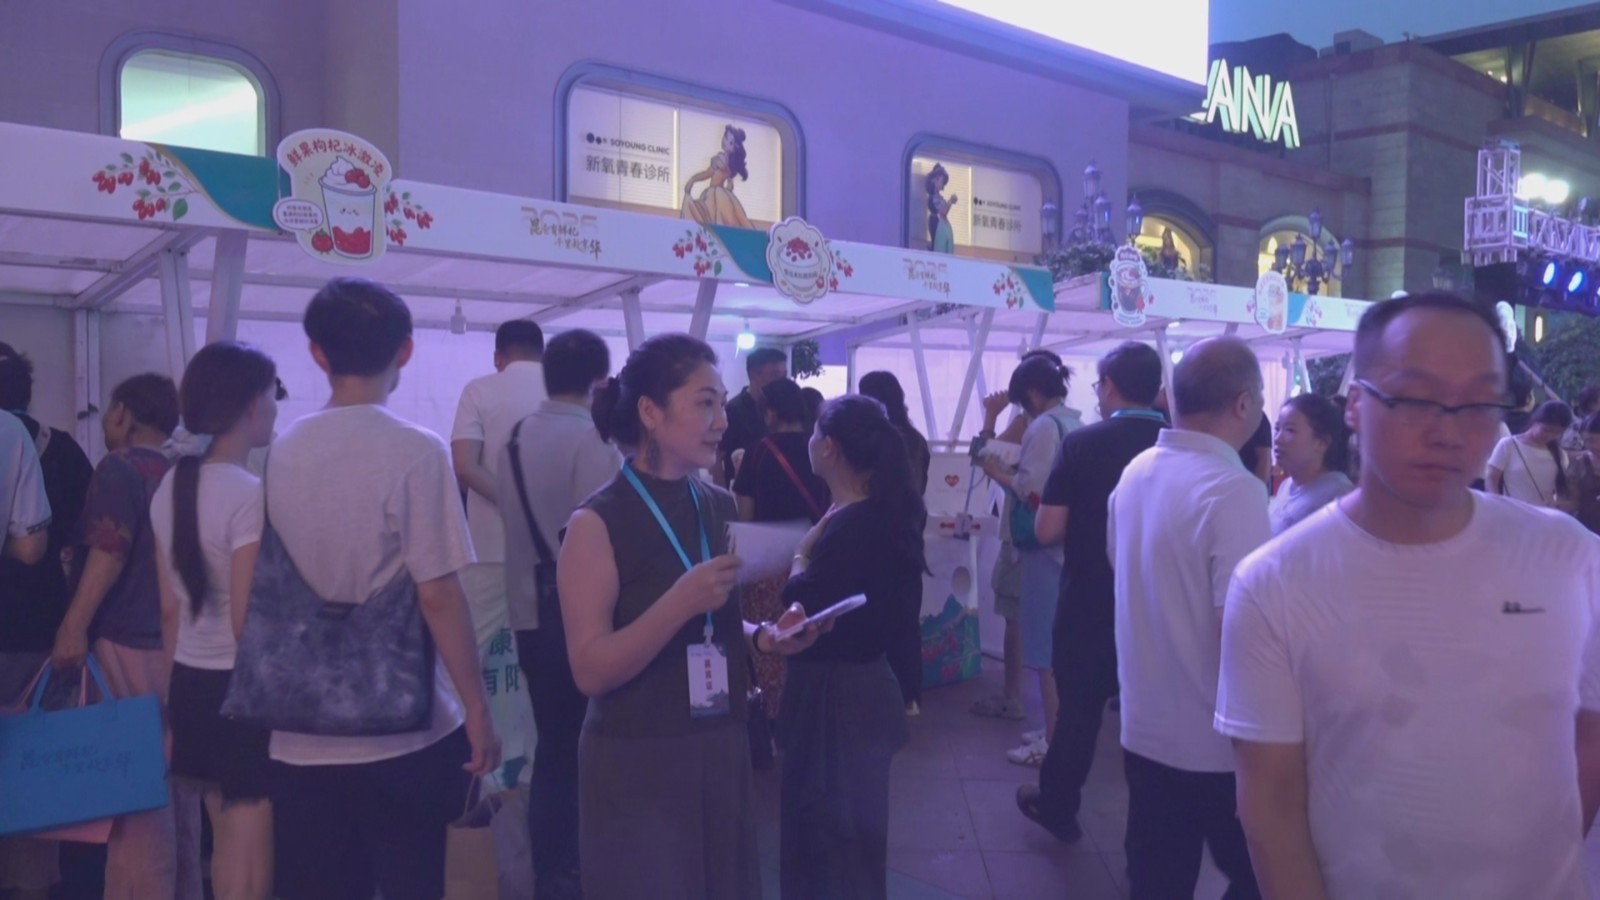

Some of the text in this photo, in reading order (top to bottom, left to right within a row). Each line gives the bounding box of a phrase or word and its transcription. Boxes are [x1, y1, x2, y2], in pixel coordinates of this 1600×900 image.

[287, 139, 383, 178] 鲜果枸杞冰激凌
[611, 138, 670, 156] SOYOUNG CLINIC
[586, 154, 670, 183] 新氧青春诊所
